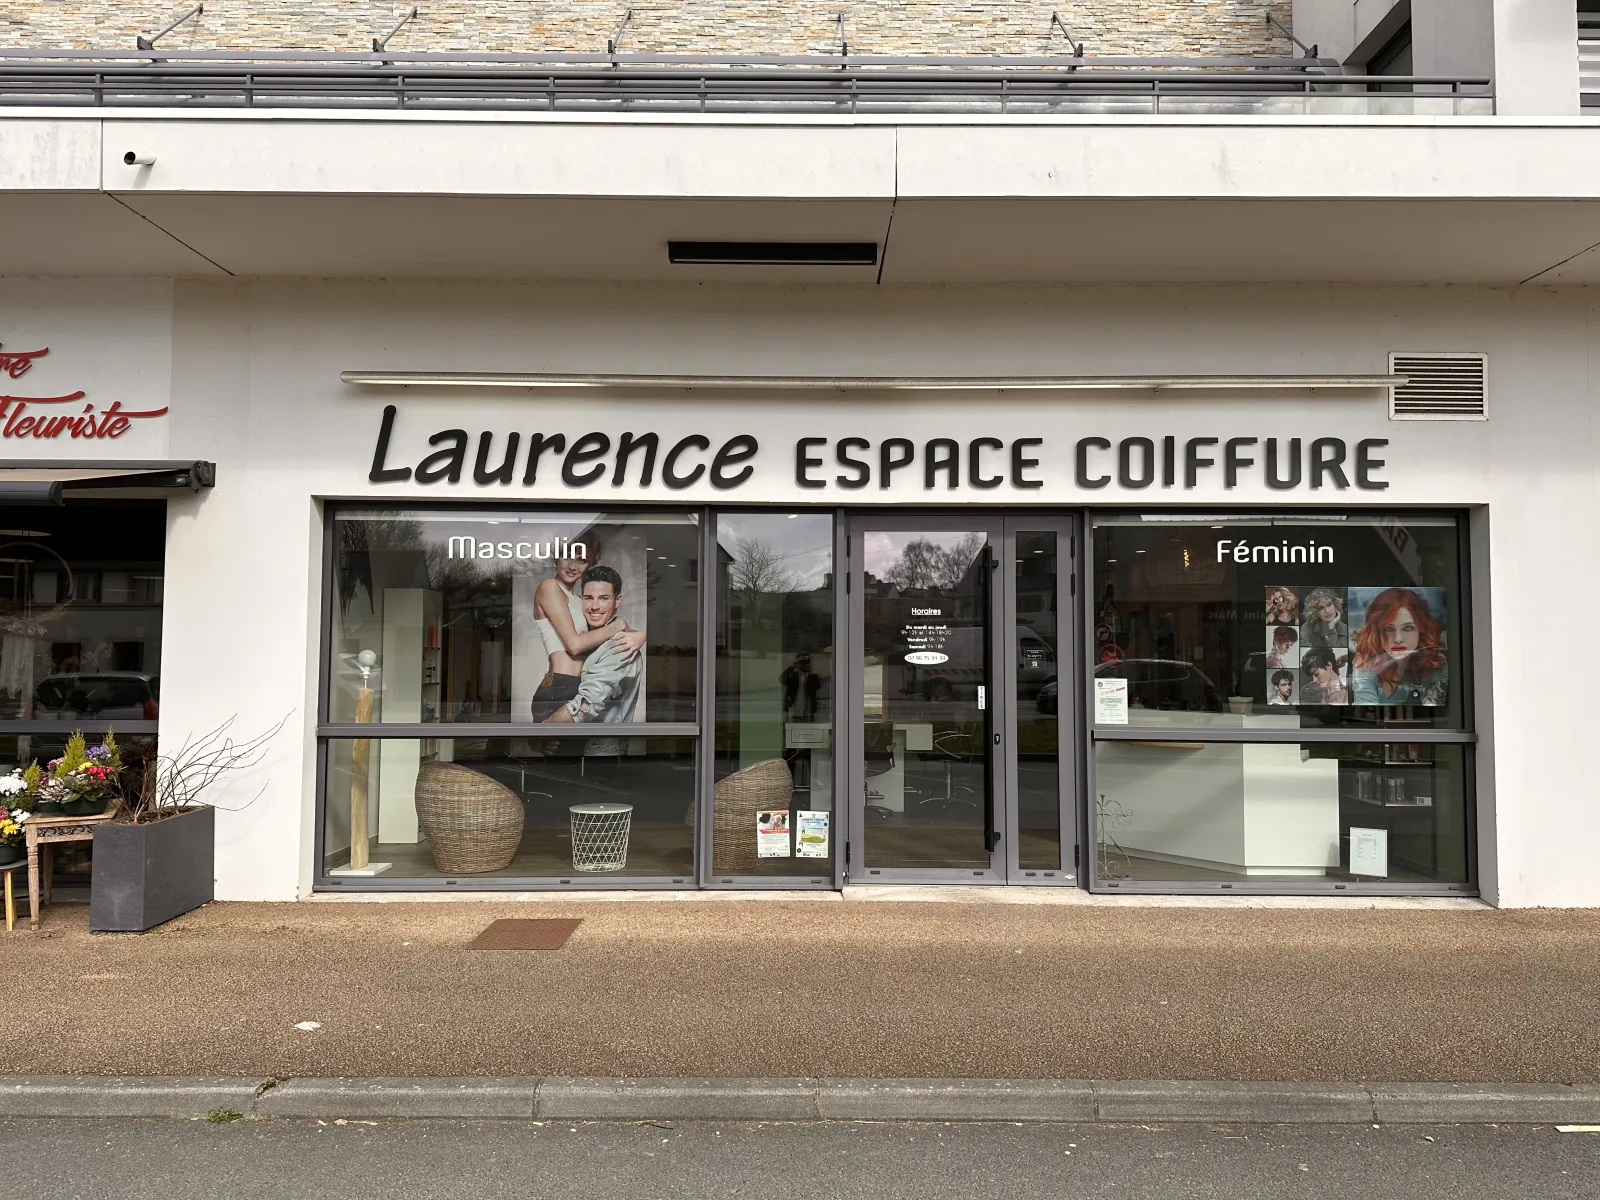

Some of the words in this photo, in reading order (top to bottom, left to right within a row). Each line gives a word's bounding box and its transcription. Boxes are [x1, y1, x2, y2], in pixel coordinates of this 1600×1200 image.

[368, 404, 759, 489] Laurence
[796, 437, 1044, 489] ESPACE
[1075, 435, 1390, 489] COIFFURE
[448, 535, 587, 560] Masculin
[1217, 540, 1334, 563] Féminin
[911, 607, 942, 616] Horaires
